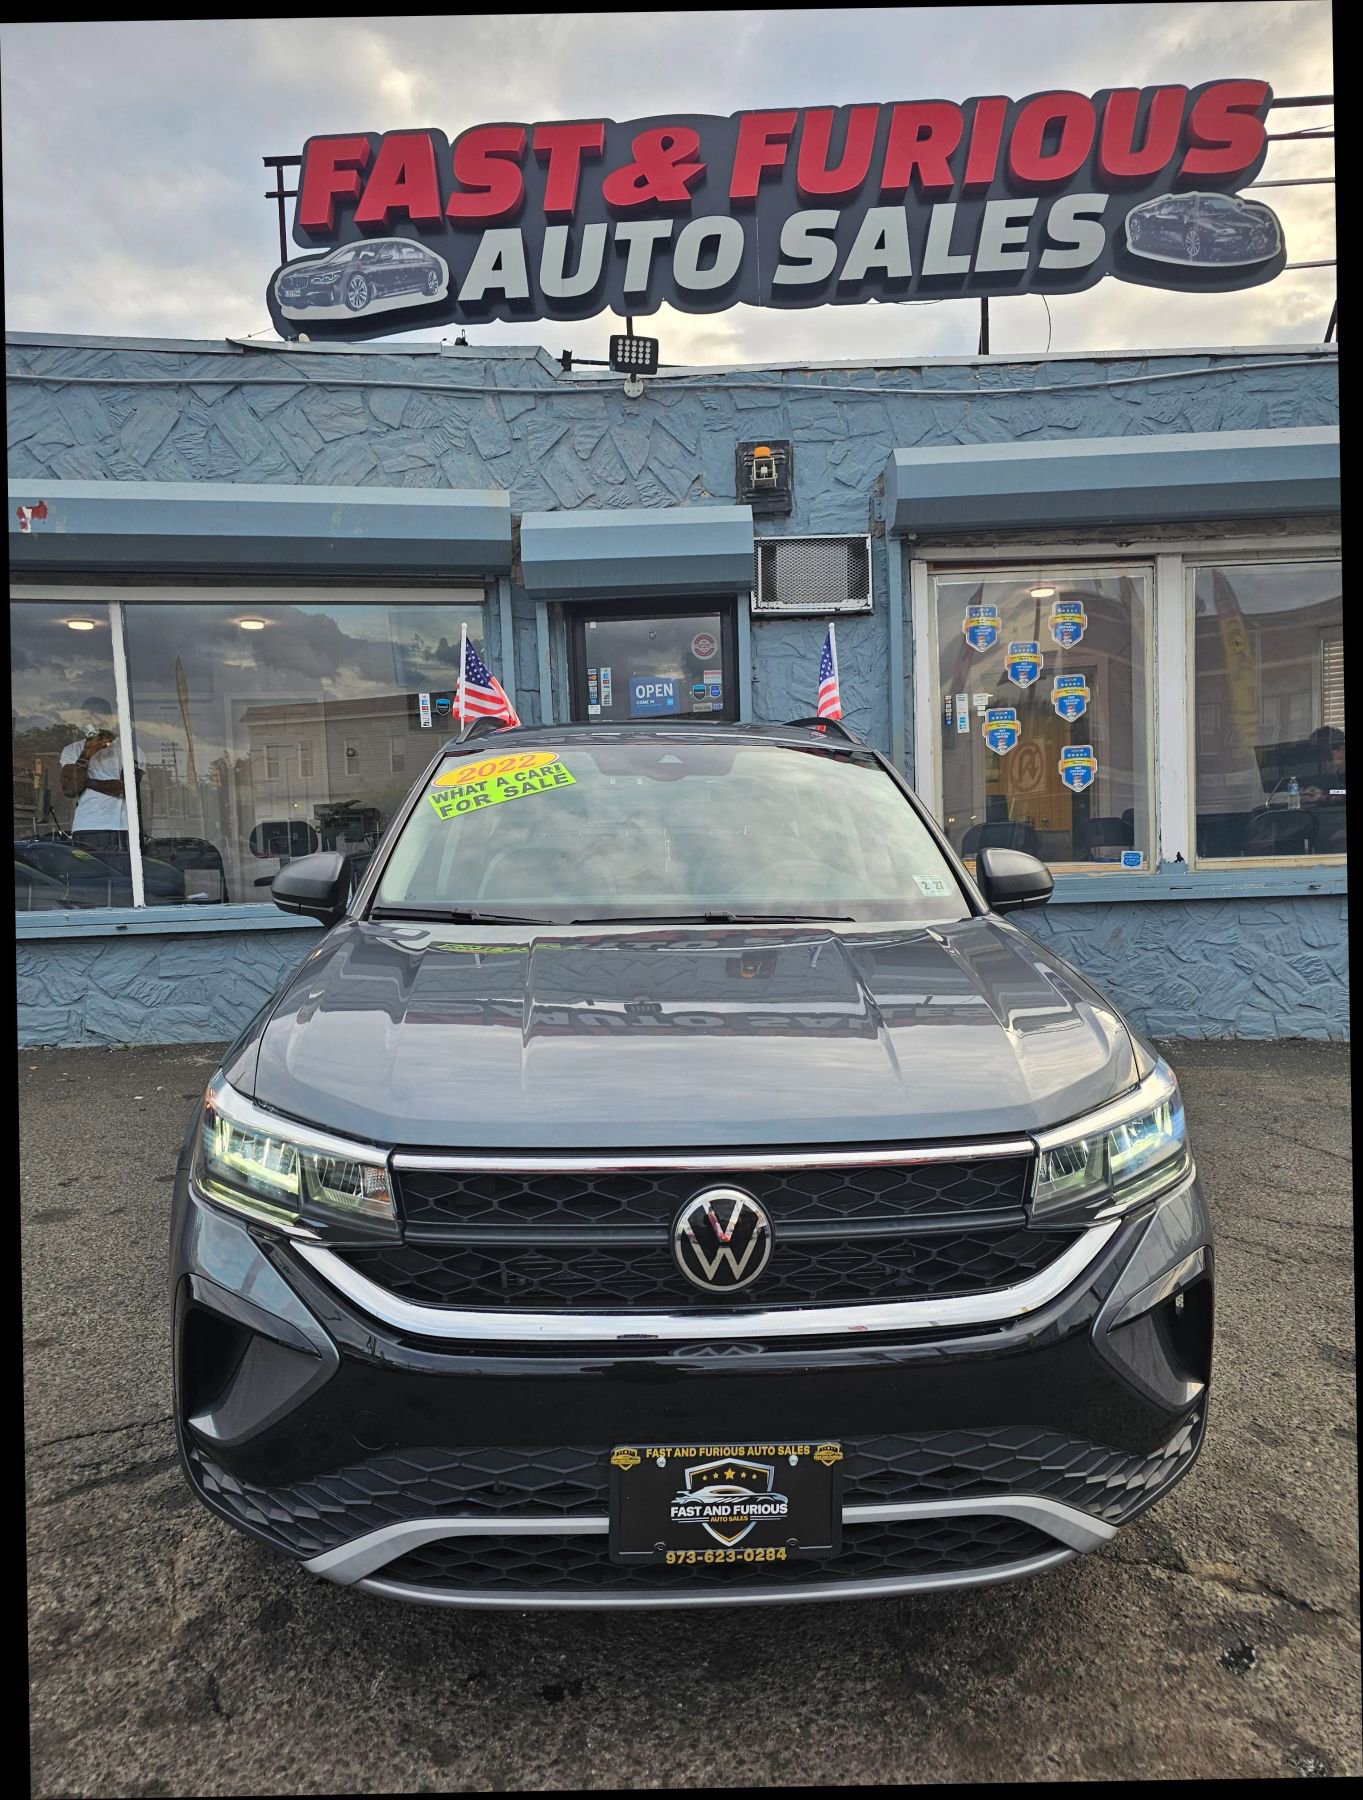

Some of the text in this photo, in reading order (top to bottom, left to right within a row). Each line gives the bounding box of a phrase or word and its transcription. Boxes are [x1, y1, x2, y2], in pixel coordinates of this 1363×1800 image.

[300, 80, 1270, 231] FAST & FURIOUS
[458, 193, 1109, 301] AUTO SALES
[635, 683, 673, 699] OPEN
[432, 764, 561, 804] WHAT A CAR!
[456, 754, 536, 784] 2022
[439, 773, 569, 818] FOR SALE
[646, 1445, 810, 1458] FAST AND FURIOUS AUTO SALES
[671, 1503, 788, 1517] FAST AND FURIOUS
[665, 1548, 787, 1565] 973-623-0284
